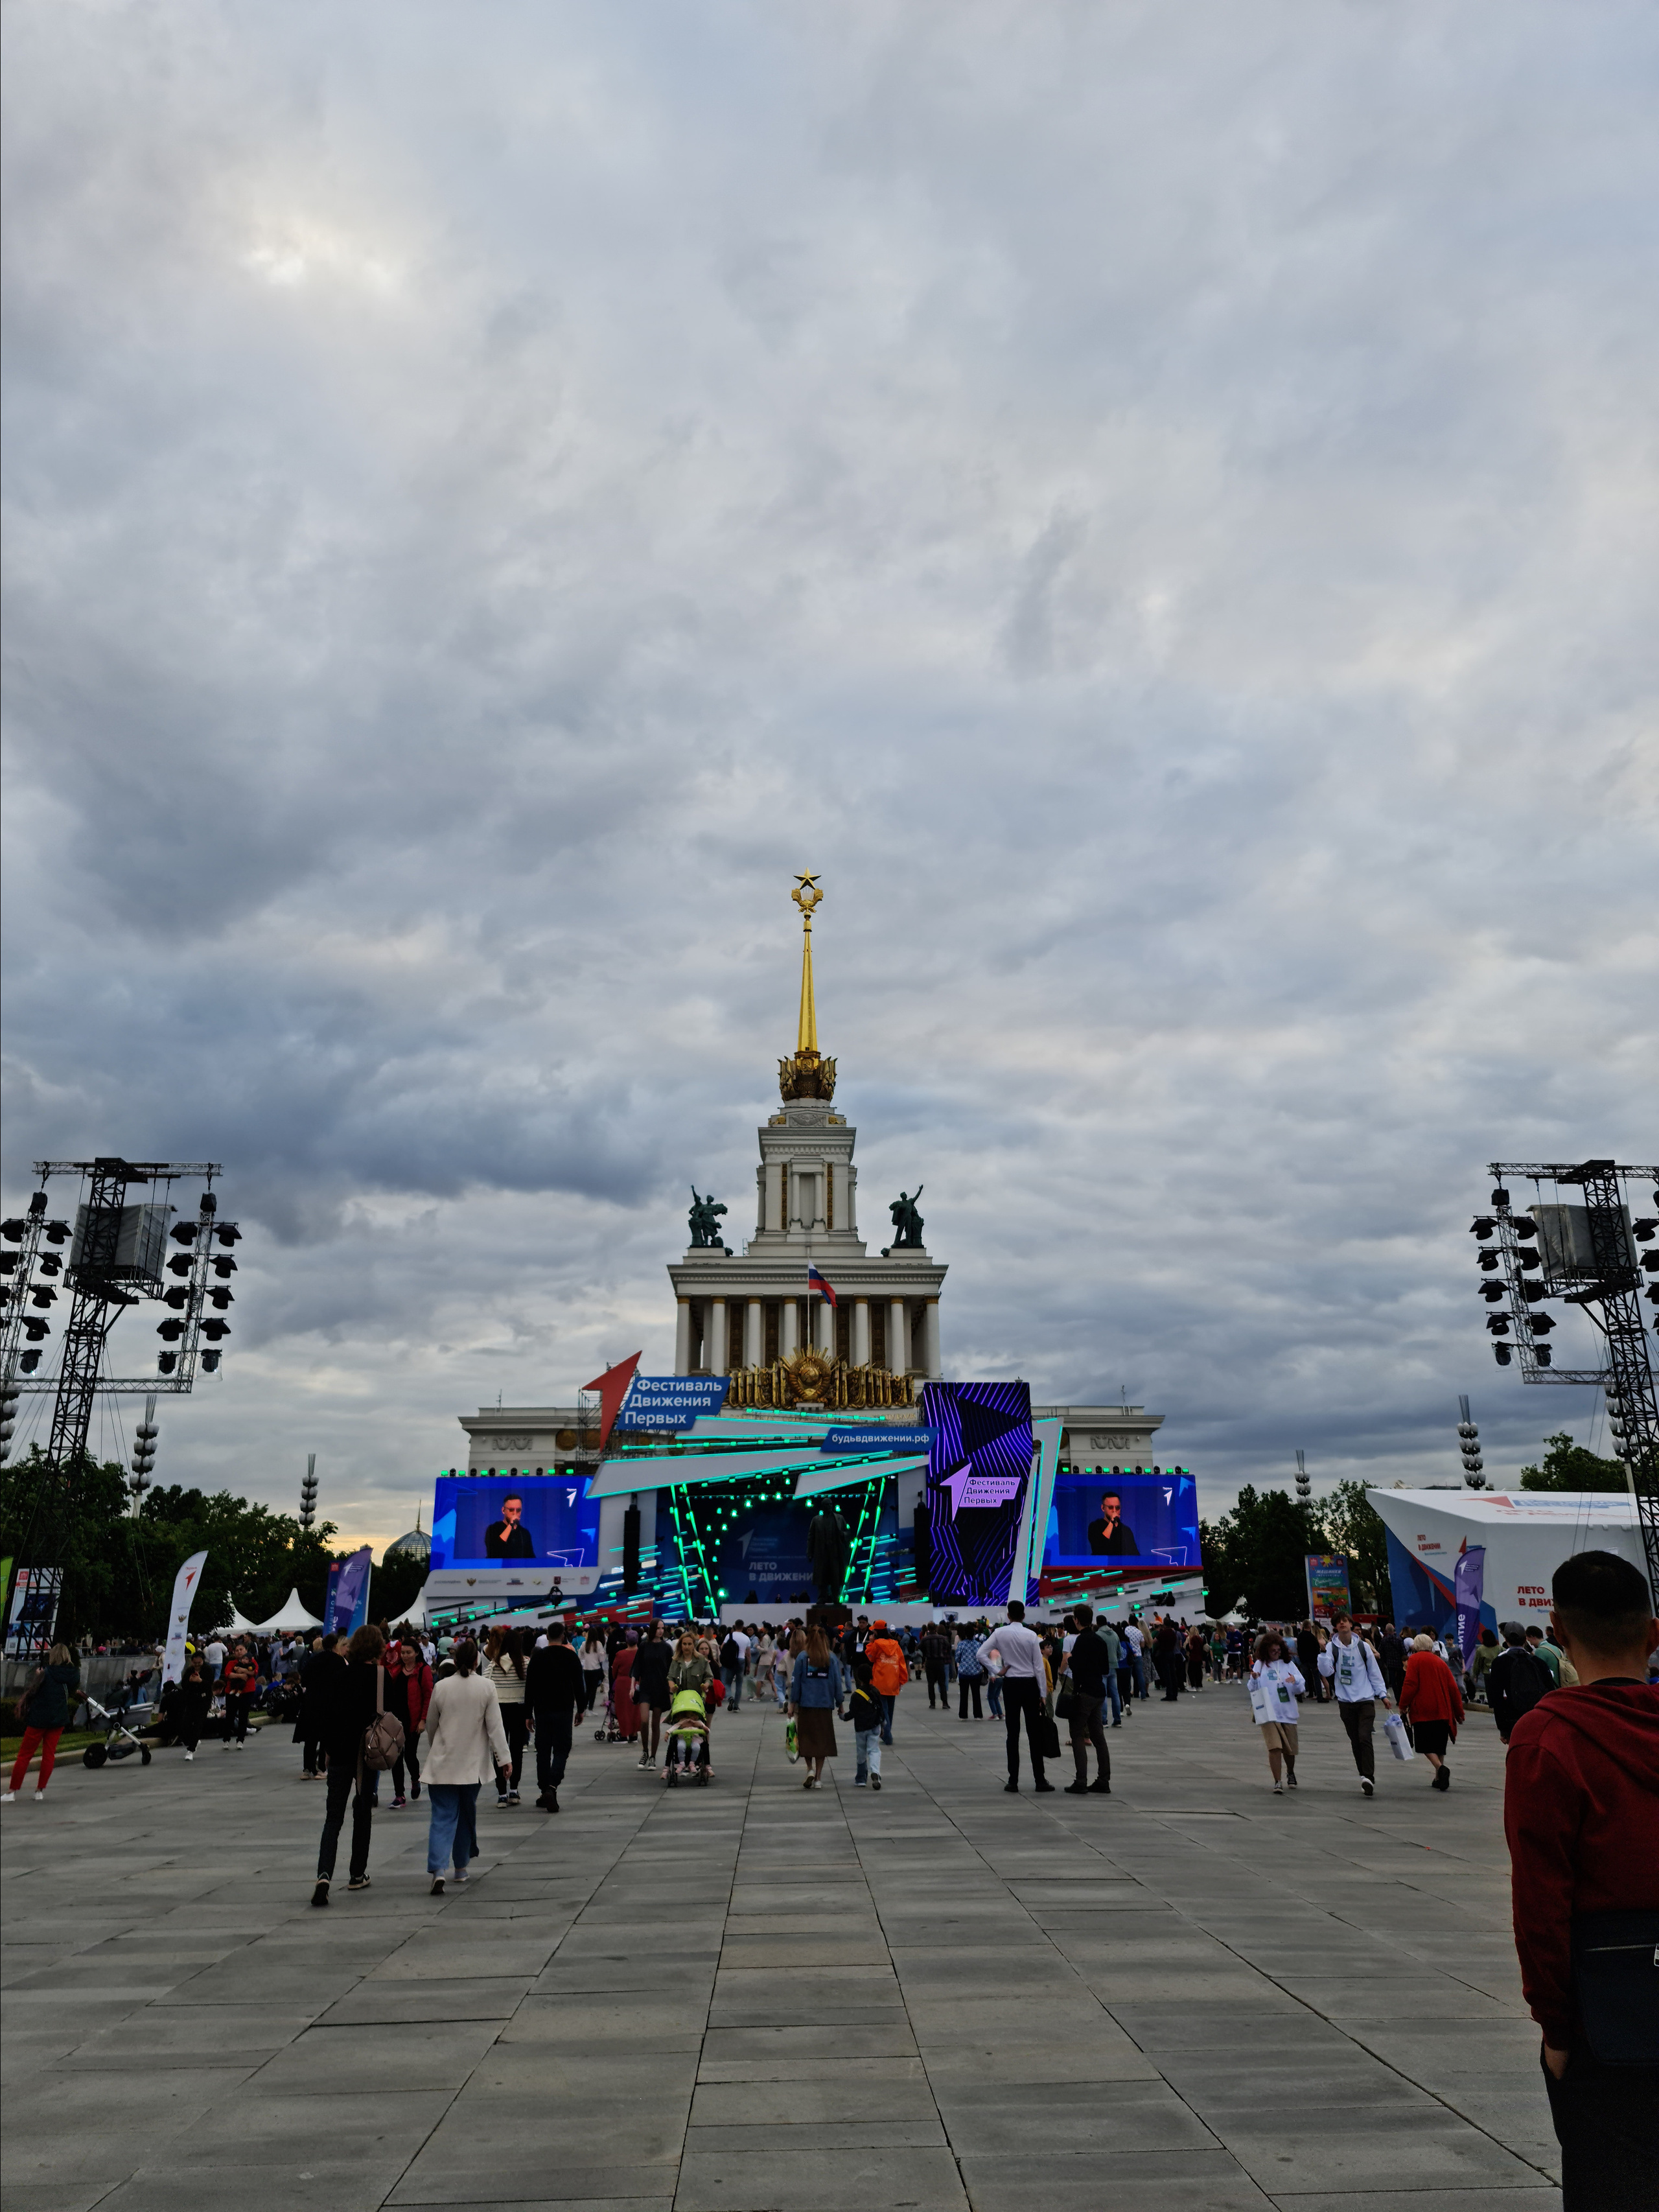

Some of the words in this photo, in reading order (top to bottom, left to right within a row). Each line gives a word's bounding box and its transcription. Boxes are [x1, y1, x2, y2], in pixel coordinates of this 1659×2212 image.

[637, 1379, 722, 1391] Фестиваль
[629, 1394, 711, 1408] Движения
[625, 1412, 686, 1426] Первых
[831, 1434, 929, 1444] будьвдвижении.рф
[748, 1572, 756, 1581] В
[759, 1572, 813, 1582] ДВИЖЕНИ
[1517, 1586, 1545, 1594] ЛЕТО
[1518, 1598, 1526, 1606] В
